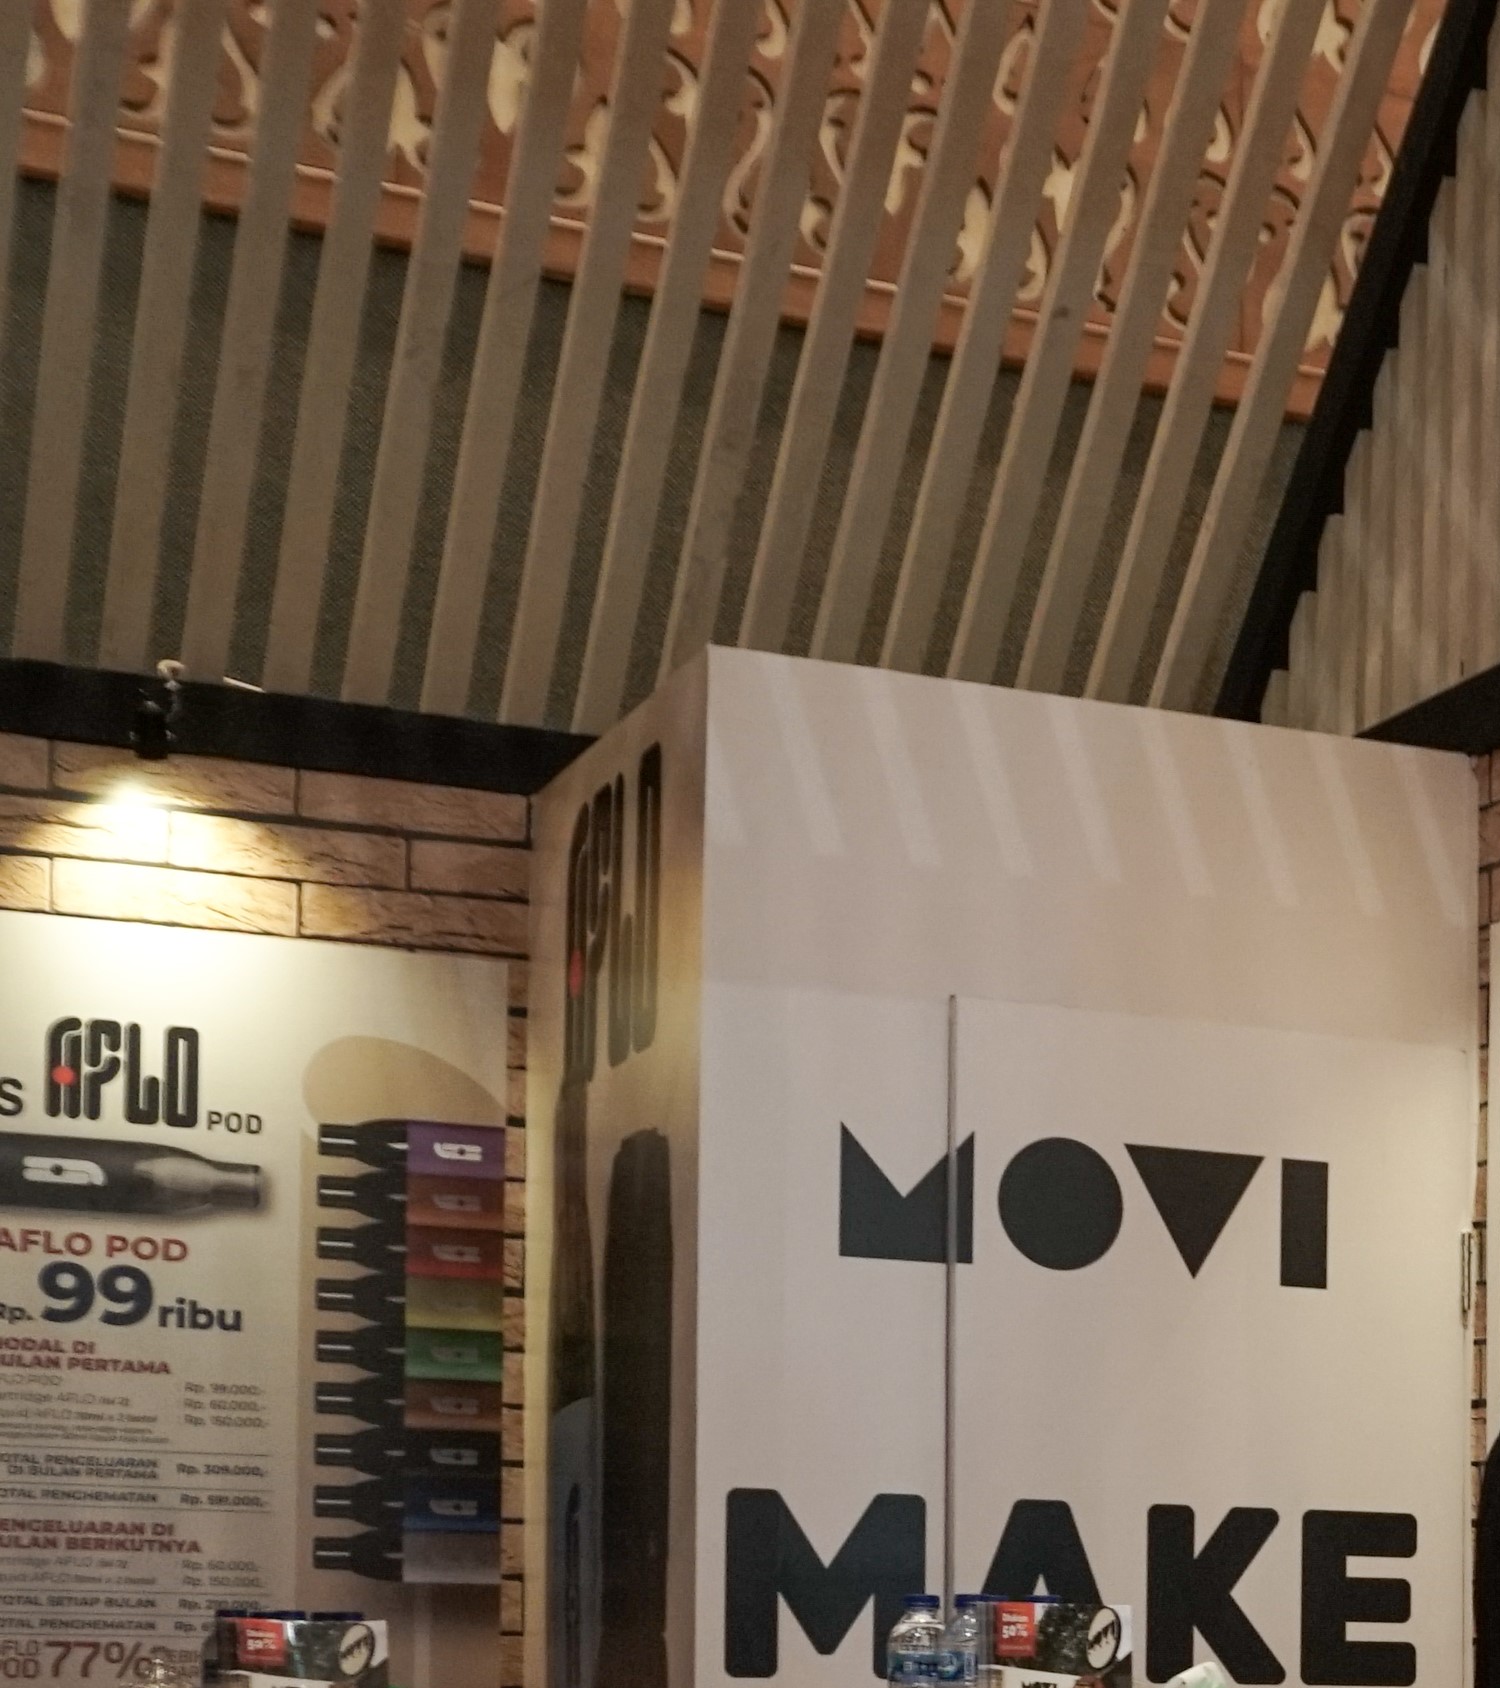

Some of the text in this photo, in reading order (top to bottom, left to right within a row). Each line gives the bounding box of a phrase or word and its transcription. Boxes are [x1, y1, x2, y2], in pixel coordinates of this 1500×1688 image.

[45, 1016, 199, 1128] AFLO
[207, 1110, 263, 1134] POD
[840, 1121, 1328, 1289] MOVI
[0, 1228, 189, 1262] AFLO POD
[38, 1261, 153, 1326] 99
[158, 1298, 242, 1332] ribu
[67, 1356, 171, 1374] PERTAMA
[64, 1535, 202, 1554] BERIKUTNYA
[151, 1522, 175, 1537] DI
[724, 1487, 1417, 1687] MAKE
[46, 1640, 152, 1681] 77%
